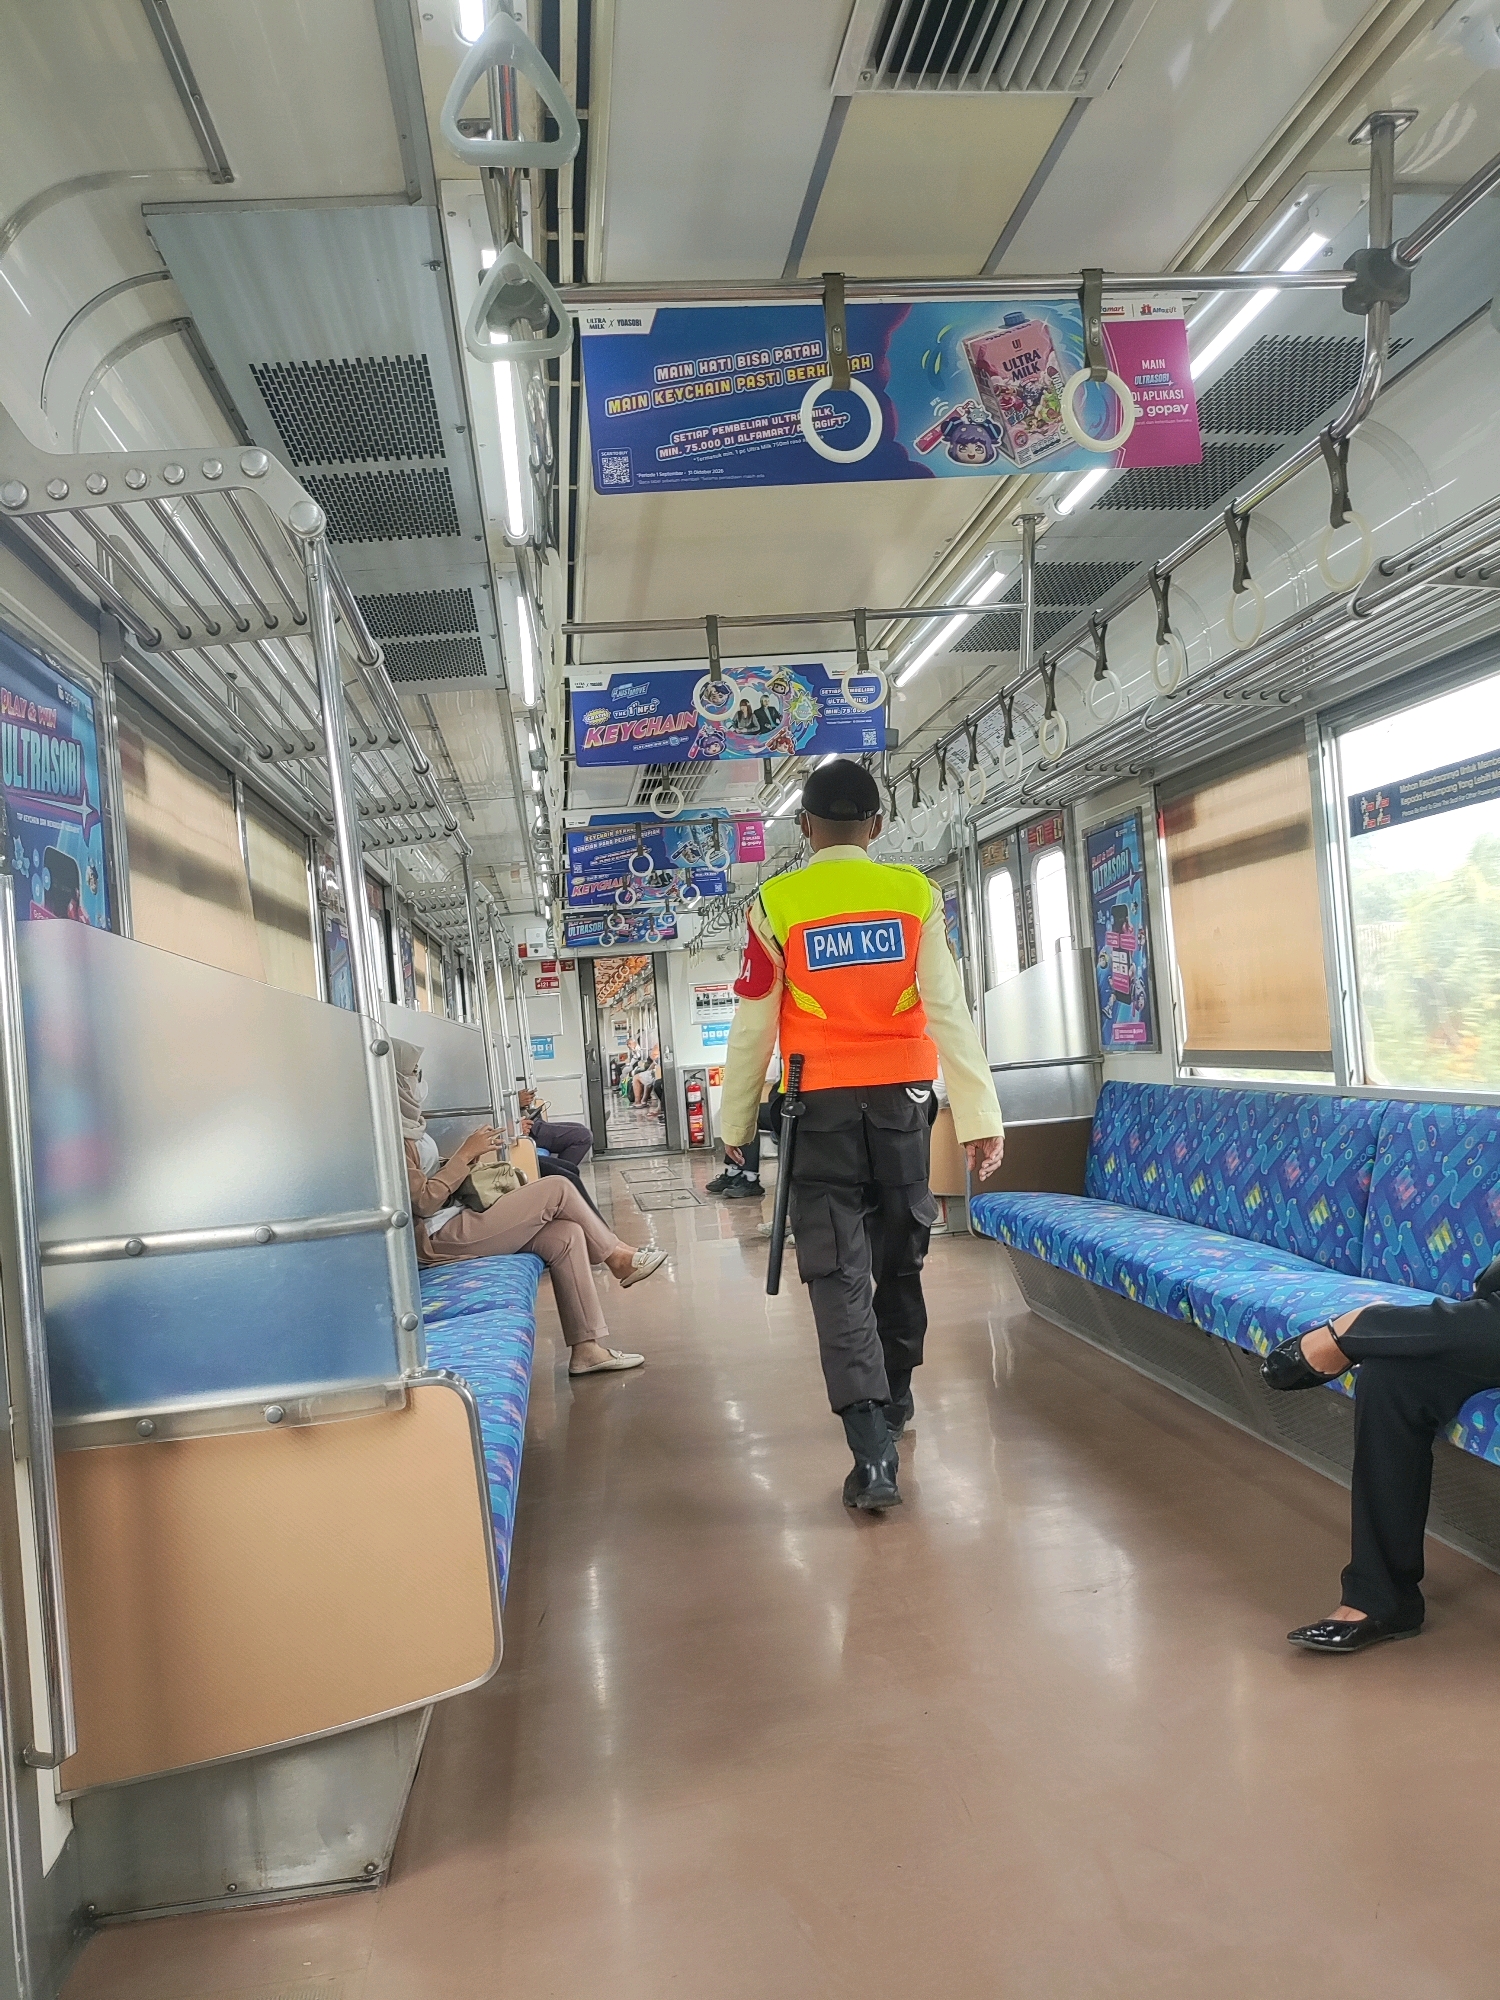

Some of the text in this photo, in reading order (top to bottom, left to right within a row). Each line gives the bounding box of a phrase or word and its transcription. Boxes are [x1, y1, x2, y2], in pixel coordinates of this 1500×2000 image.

[1152, 306, 1177, 314] Alfagift
[616, 319, 642, 327] YOASOBI
[656, 342, 820, 381] MAIN HATI BISA PATAH
[1002, 349, 1042, 372] ULTRA
[1141, 359, 1166, 370] MAIN
[1011, 362, 1042, 383] MILK
[1134, 373, 1170, 385] ULTRASOBI
[607, 393, 648, 414] MAIN
[654, 379, 731, 405] KEYCHAIN
[736, 371, 782, 391] PASTI
[1131, 389, 1185, 402] DI APLIKASI
[1146, 403, 1189, 417] gopay
[673, 429, 709, 444] SETIAP
[712, 420, 768, 436] PEMBELIAN
[659, 446, 682, 459] MIN.
[685, 438, 721, 453] 75.000
[724, 435, 735, 446] DI
[0, 687, 57, 729] PLAY & WIN
[638, 703, 655, 714] NFC
[583, 709, 699, 749] KEYCHAIN
[0, 721, 82, 798] ULTRASOBI
[1092, 849, 1129, 895] ULTRASOBI
[568, 921, 605, 937] ULTRASOBI
[812, 927, 896, 960] PAM KCI
